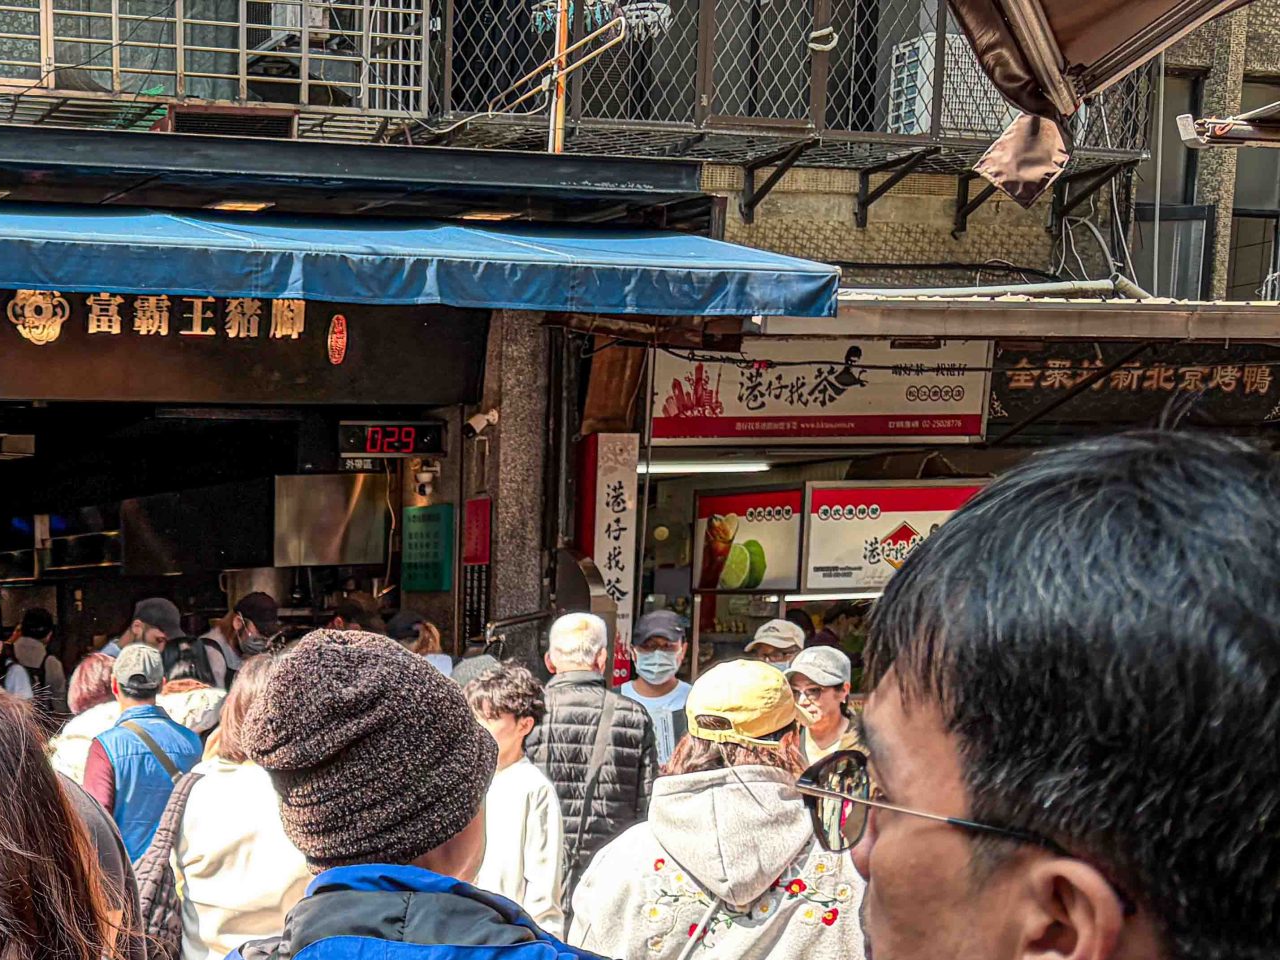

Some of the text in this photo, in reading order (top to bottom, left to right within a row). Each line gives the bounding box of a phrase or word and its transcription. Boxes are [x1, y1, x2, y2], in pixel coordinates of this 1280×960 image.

[86, 292, 306, 340] 富霸王豬腳
[366, 427, 415, 453] 029
[605, 480, 628, 601] 港仔找茶
